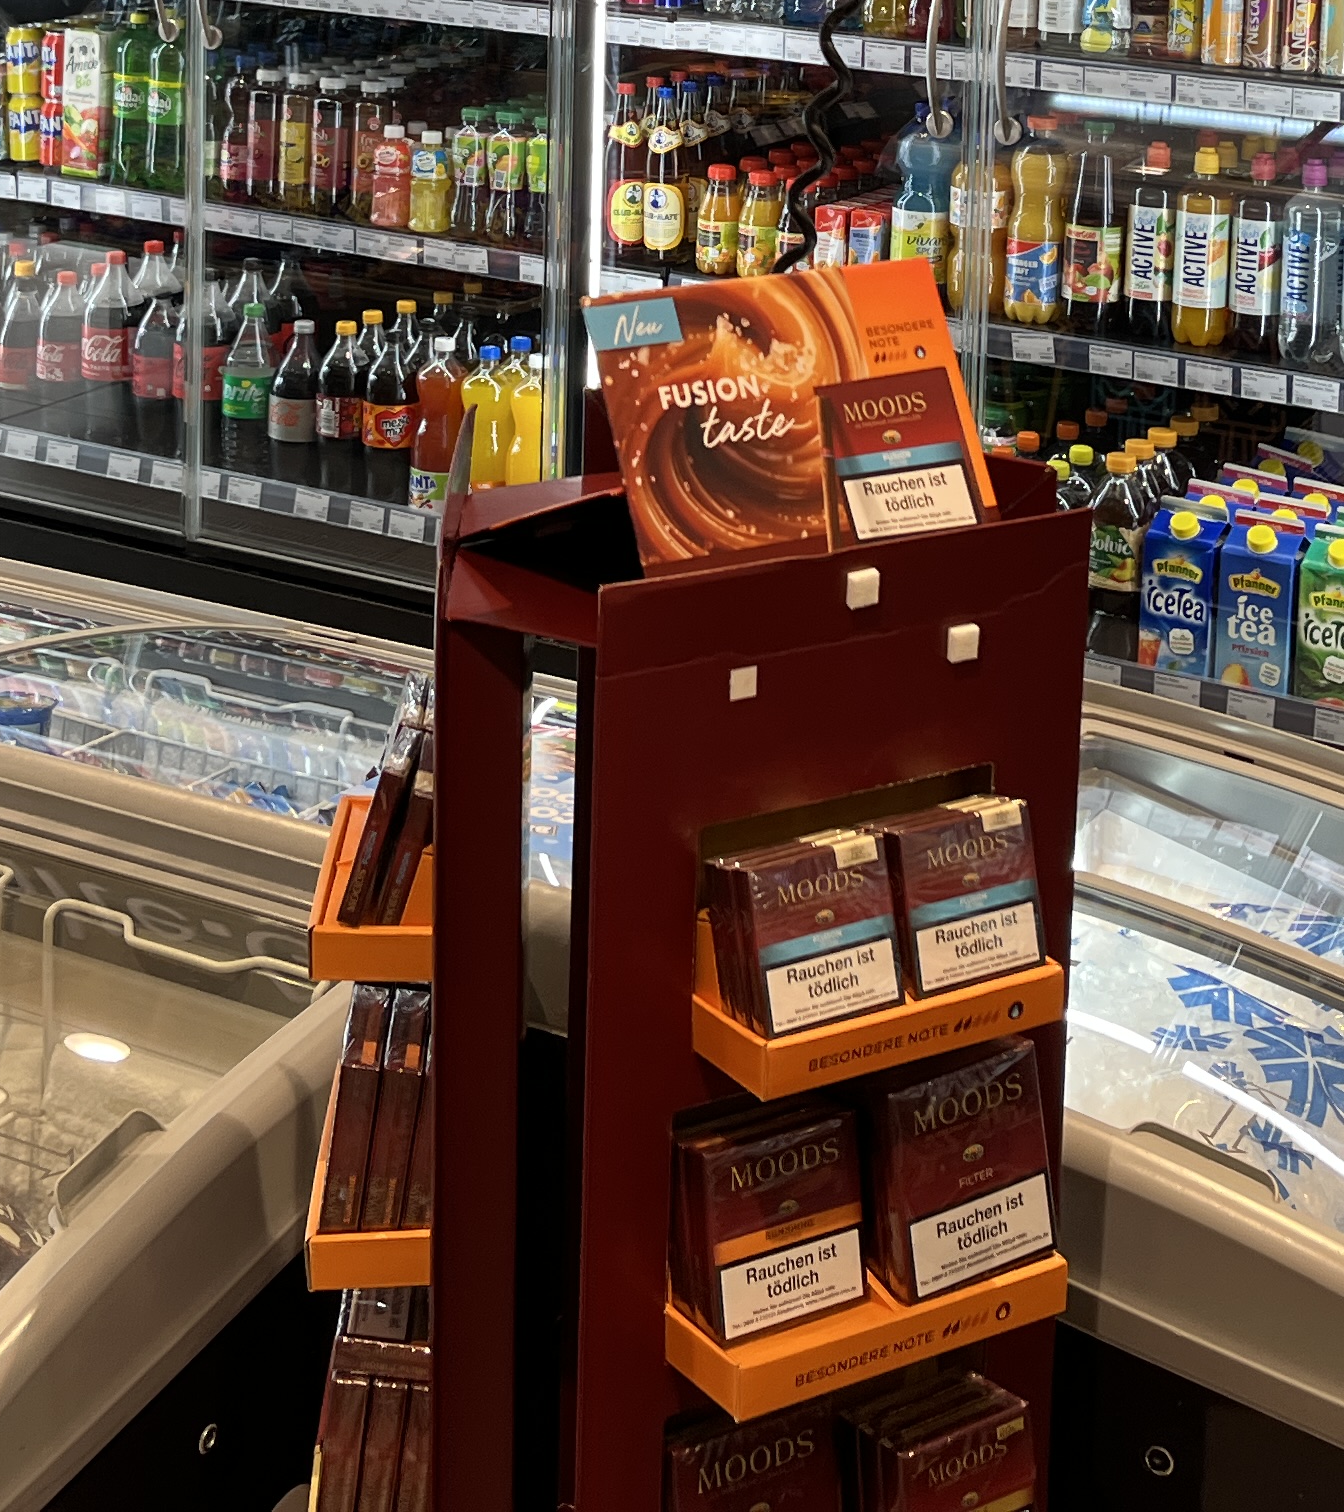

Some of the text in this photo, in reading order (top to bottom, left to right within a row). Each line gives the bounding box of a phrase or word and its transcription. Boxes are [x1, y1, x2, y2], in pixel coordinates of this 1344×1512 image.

[1131, 222, 1155, 280] ACTIVE
[1184, 230, 1207, 287] ACTIVE
[1236, 235, 1258, 294] ACTIVE
[614, 306, 662, 344] Neu
[866, 319, 935, 337] BESONDERE
[869, 337, 900, 348] NOTE
[658, 374, 760, 410] FUSION
[843, 392, 926, 424] MOODS
[700, 399, 802, 449] taste
[862, 472, 947, 497] Rauchen ist
[885, 492, 934, 512] tödlich
[1154, 562, 1201, 584] pfanner
[1232, 575, 1279, 596] pfanner
[1237, 595, 1274, 625] ice
[1227, 616, 1276, 647] tea
[926, 832, 1008, 870] MOODS
[778, 869, 864, 906] MOODS
[935, 911, 1017, 945] Rauchen ist
[955, 934, 1003, 957] tödlich
[786, 947, 875, 984] Rauchen ist
[808, 974, 859, 998] tödlich
[808, 1024, 948, 1071] BESONDERE NOTE
[913, 1073, 1023, 1137] MOODS
[731, 1137, 840, 1191] MOODS
[959, 1168, 993, 1188] FILTER
[936, 1192, 1024, 1239] Rauchen ist
[957, 1220, 1008, 1250] tödlich
[746, 1244, 837, 1285] Rauchen ist
[767, 1269, 819, 1298] tödlich
[795, 1329, 935, 1387] BESONDERE NOTE
[697, 1430, 815, 1494] MOODS
[928, 1437, 1007, 1487] MOODS
